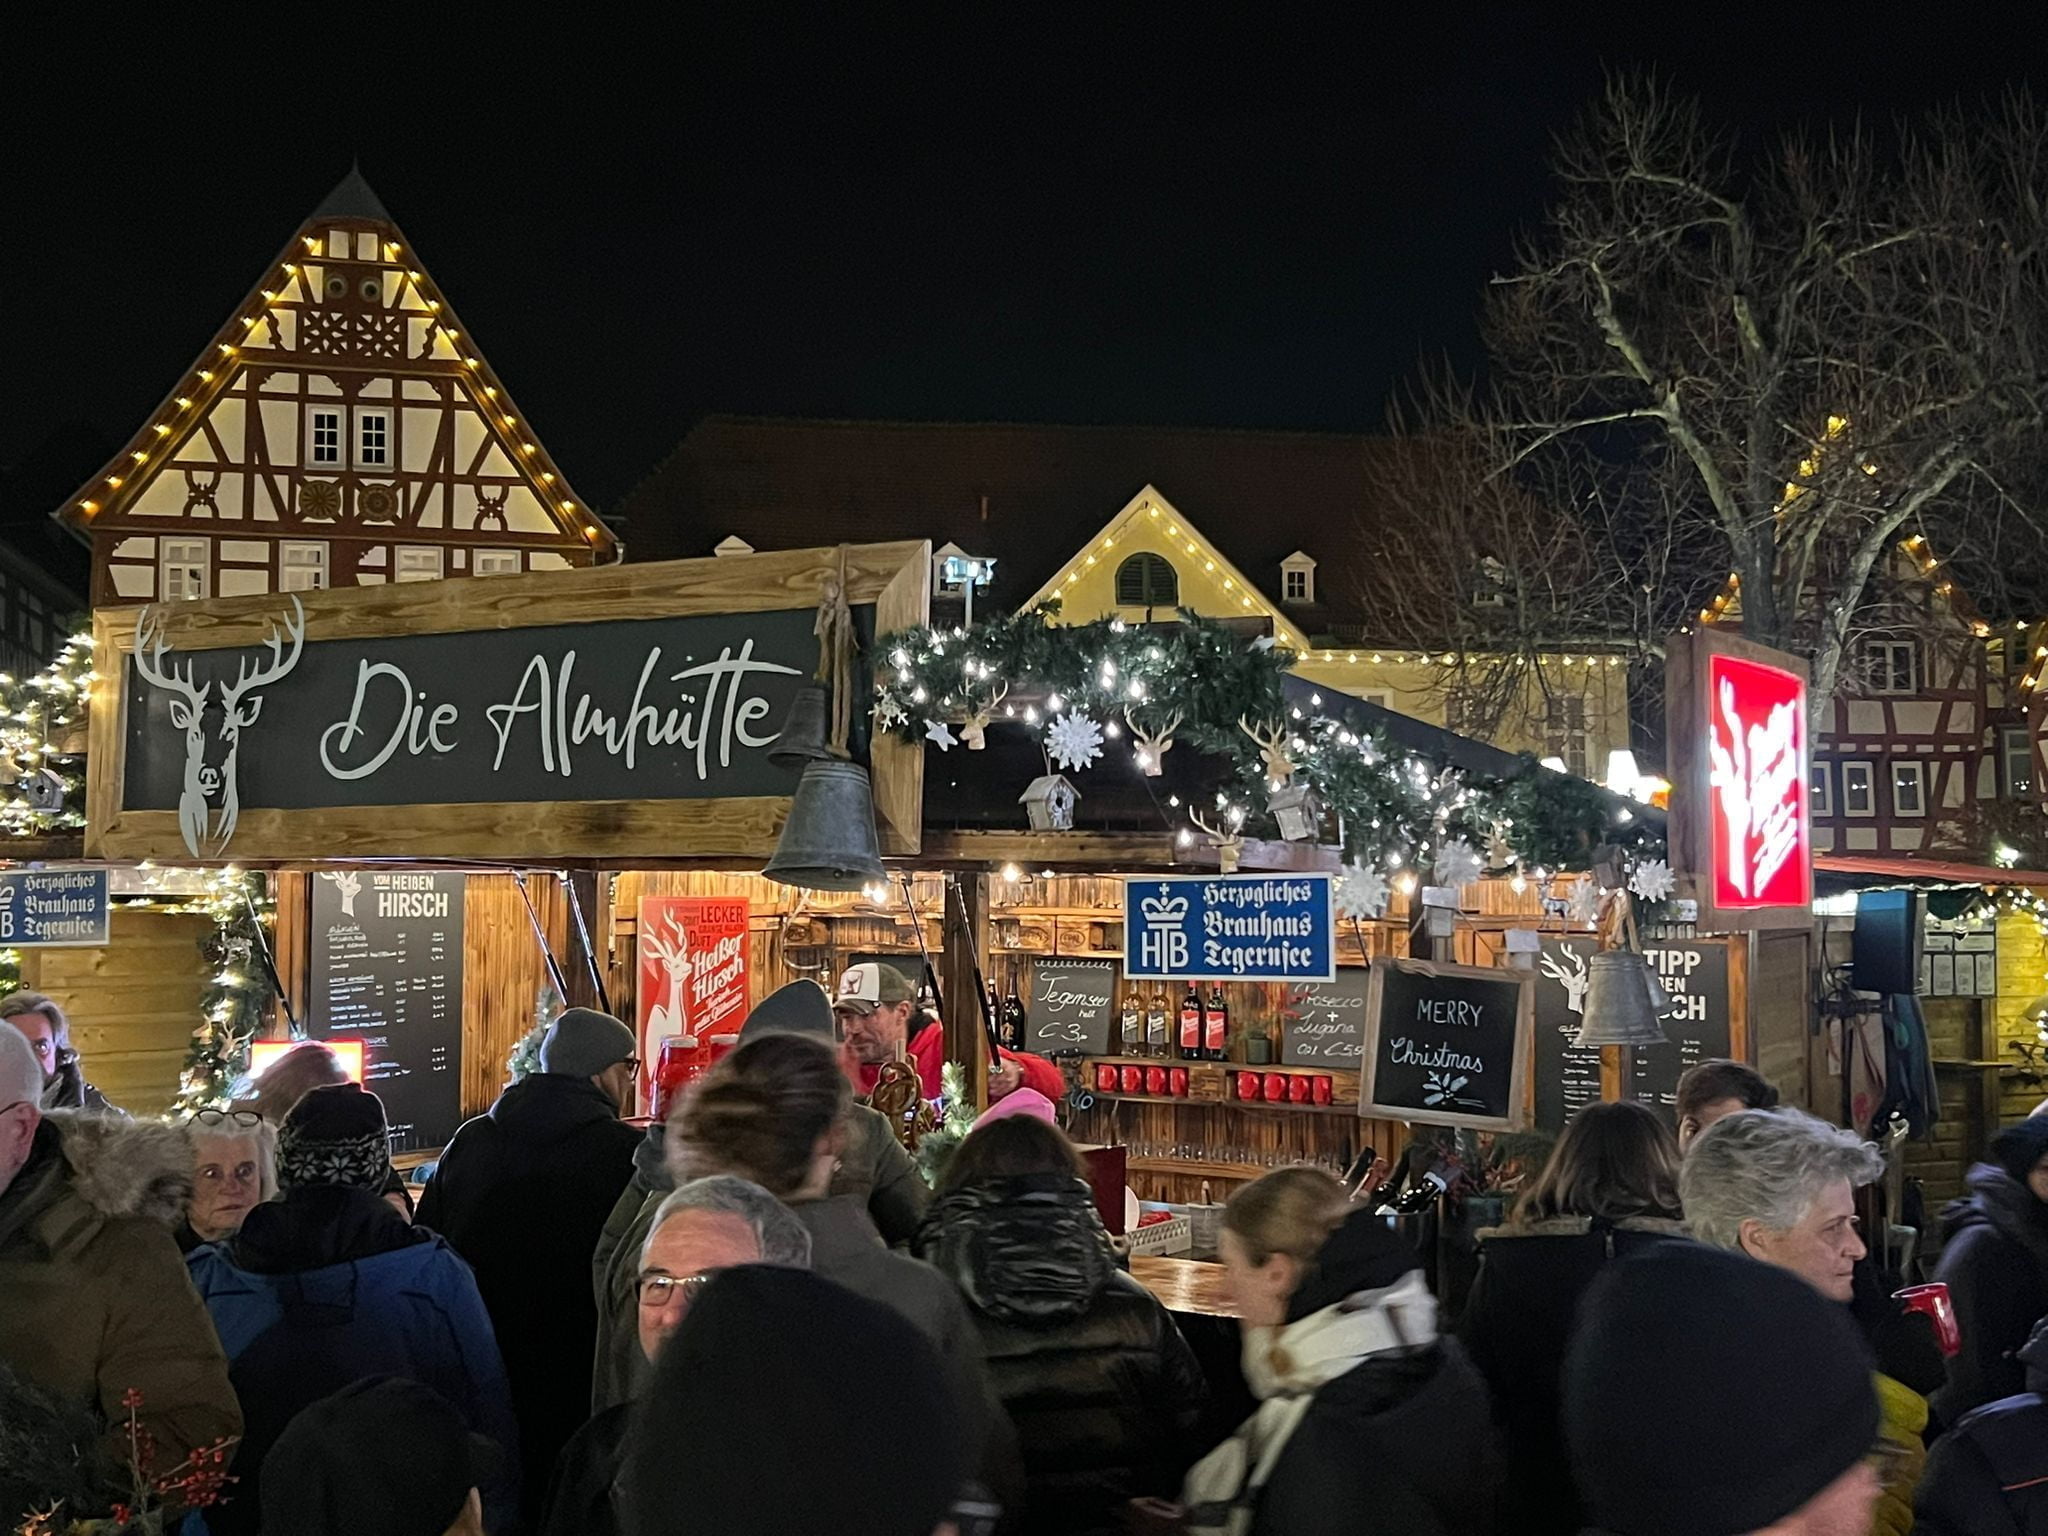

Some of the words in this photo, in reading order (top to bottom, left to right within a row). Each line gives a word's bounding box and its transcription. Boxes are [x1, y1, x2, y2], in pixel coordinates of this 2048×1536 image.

[319, 658, 458, 780] Die
[486, 639, 803, 780] Almhütte
[24, 873, 96, 892] Herzogliches
[1203, 880, 1312, 908] Herzogliches
[24, 894, 96, 917] Brauhaus
[378, 892, 448, 917] HIRSCH
[701, 905, 744, 923] LECKER
[1203, 910, 1312, 943] Brauhaus
[691, 932, 745, 983] Heißer
[692, 952, 745, 1008] Hirsch
[1416, 999, 1484, 1027] MERRY
[1390, 1037, 1484, 1074] Christmas
